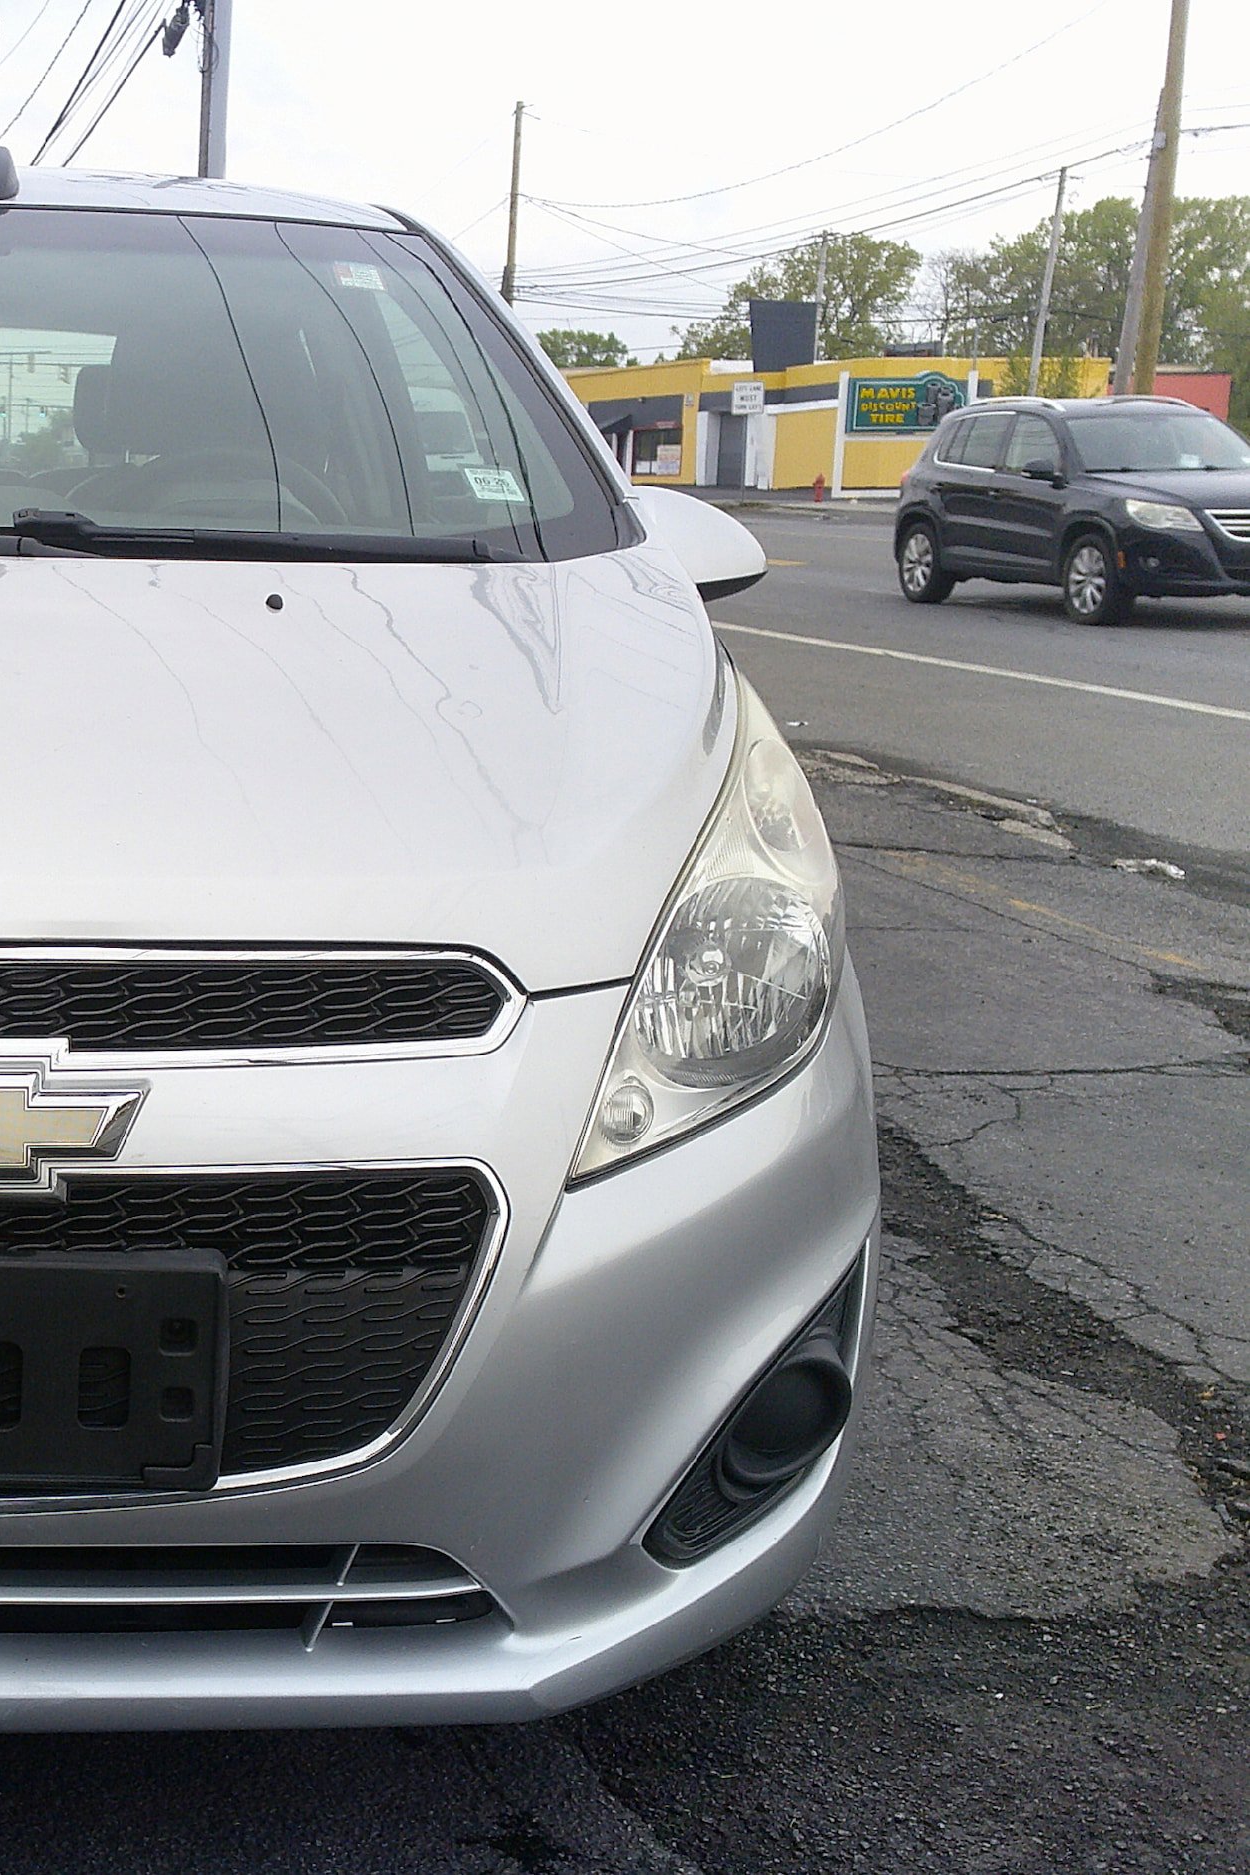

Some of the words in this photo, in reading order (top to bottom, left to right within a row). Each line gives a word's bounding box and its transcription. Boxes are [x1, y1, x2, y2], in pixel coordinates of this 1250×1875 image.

[860, 387, 916, 399] MAVIS
[861, 401, 917, 412] DISCOUNT
[870, 413, 905, 424] TIRE
